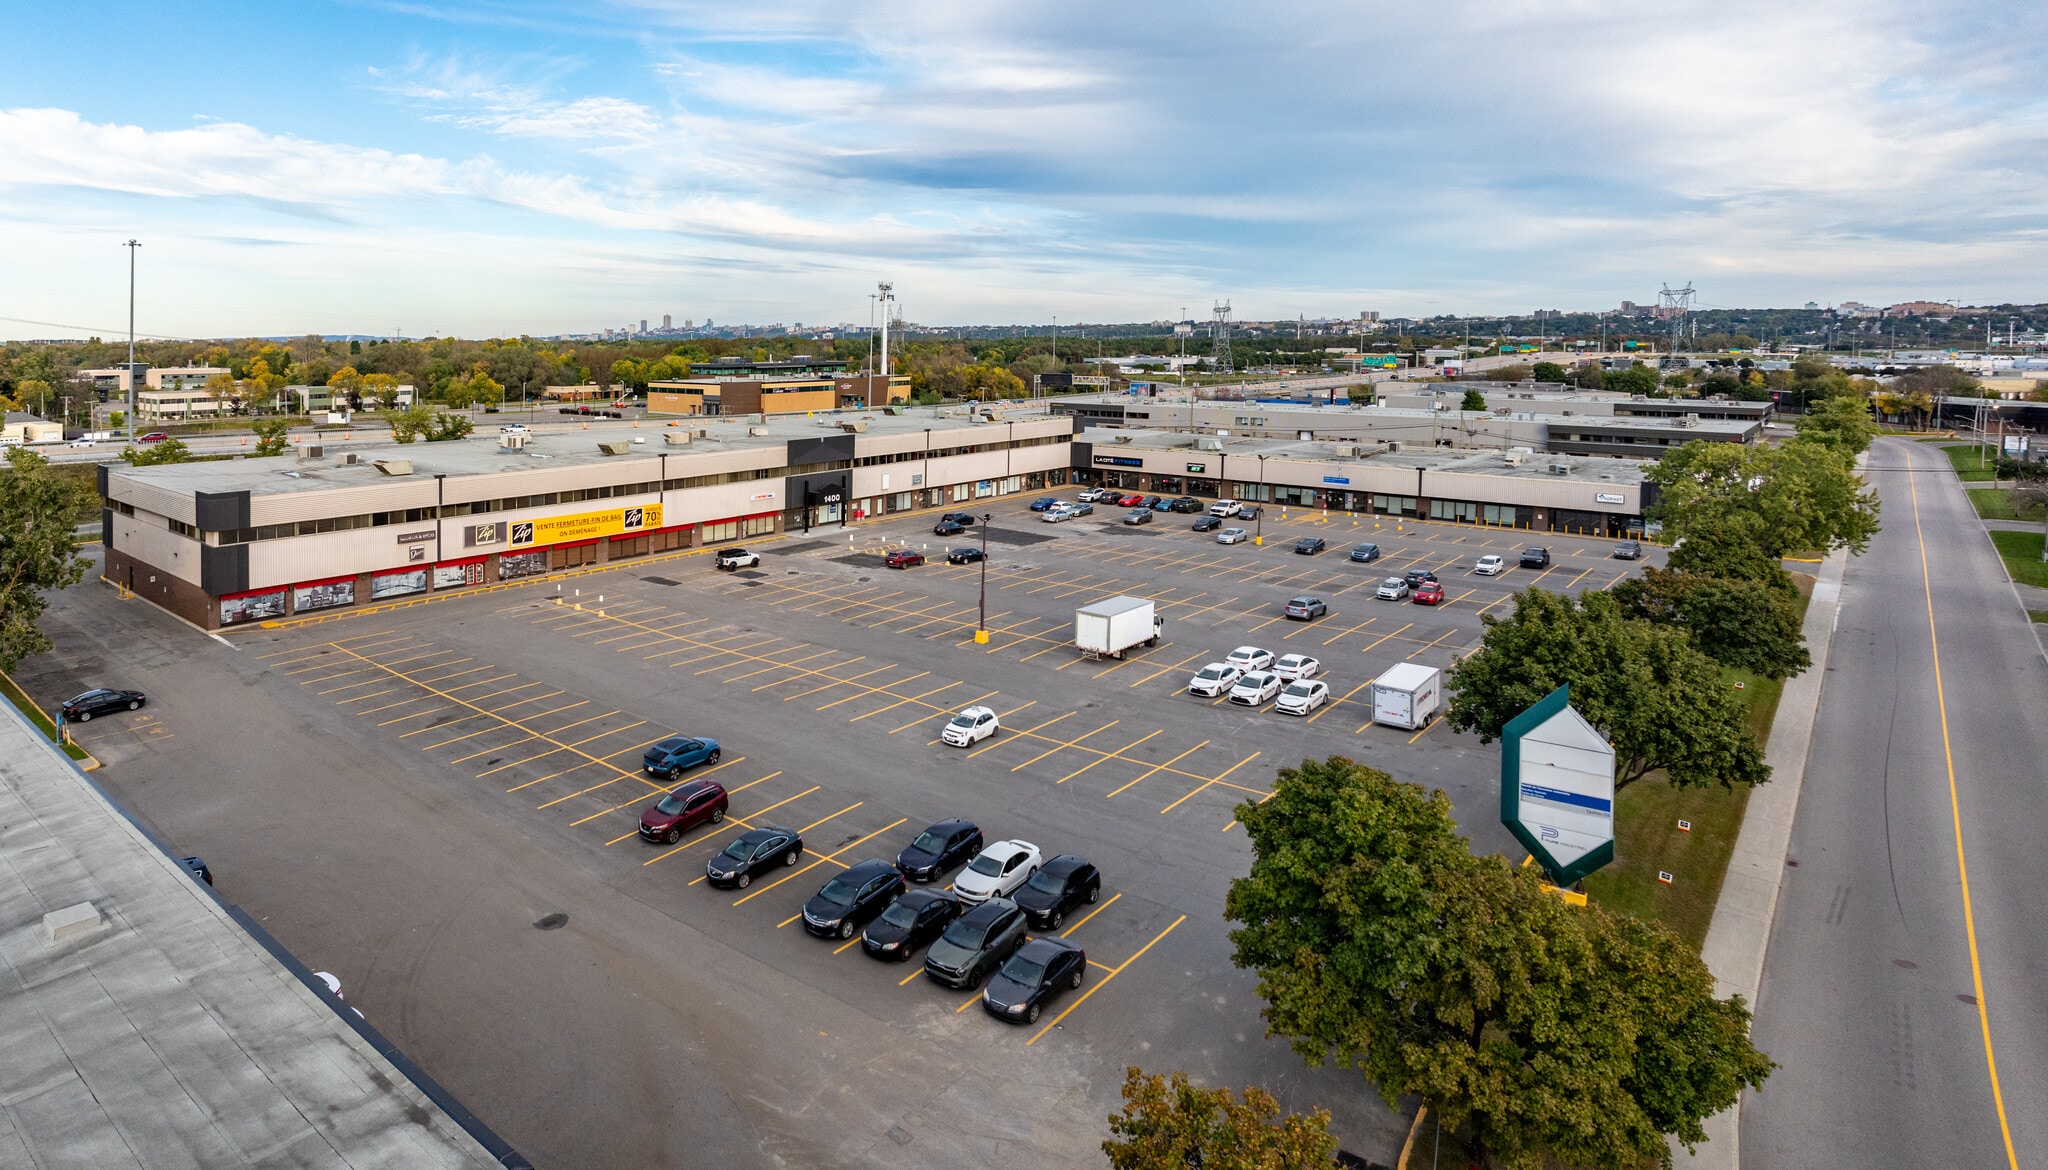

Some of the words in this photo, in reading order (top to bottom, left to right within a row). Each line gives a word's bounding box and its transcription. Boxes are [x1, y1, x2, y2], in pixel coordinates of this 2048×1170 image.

[823, 493, 841, 503] 1400
[536, 522, 555, 530] VENTE
[556, 516, 601, 528] FERMETURE-FIN
[610, 513, 622, 521] BAIL
[625, 509, 642, 526] Zip
[478, 524, 494, 541] Zip
[513, 523, 532, 542] Zip
